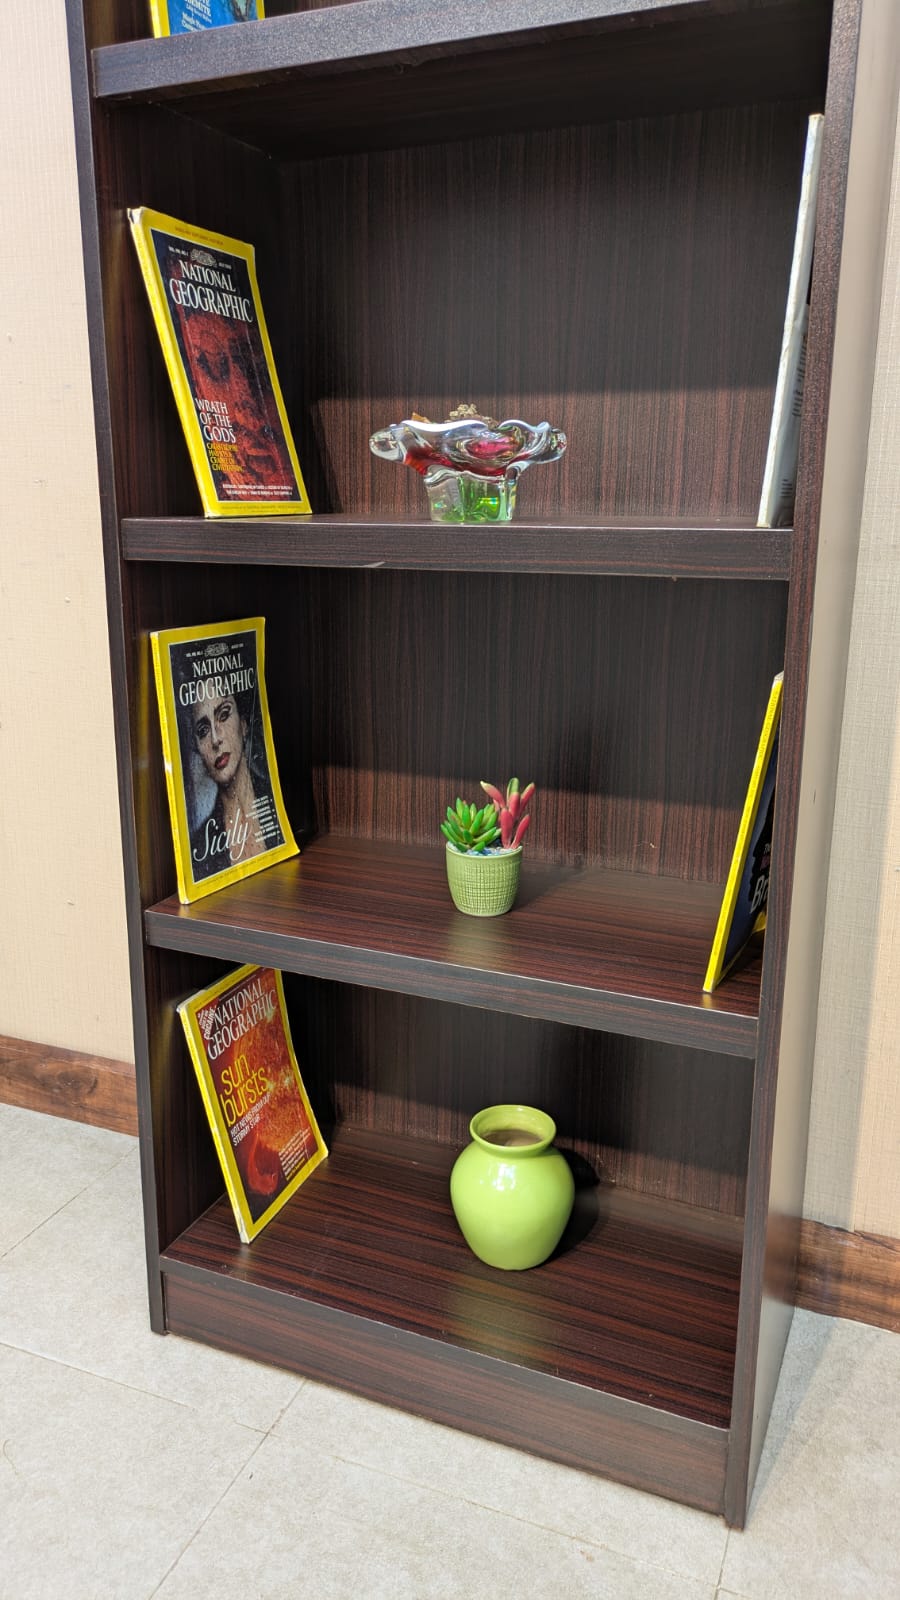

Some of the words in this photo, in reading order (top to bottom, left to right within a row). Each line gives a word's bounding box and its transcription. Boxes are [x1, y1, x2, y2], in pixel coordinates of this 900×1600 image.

[179, 260, 236, 292] NATIONAL
[169, 278, 253, 322] GEOGRAPHIC
[195, 398, 228, 414] WRATH
[200, 412, 213, 425] OF
[213, 413, 233, 428] THE
[203, 425, 236, 443] GODS
[192, 653, 243, 677] NATIONAL
[179, 668, 254, 706] GEOGRAPHIC
[193, 808, 248, 861] Sicily
[214, 978, 265, 1031] NATIONAL
[207, 989, 276, 1060] GEOGRAPHIC
[221, 1055, 250, 1095] sun
[220, 1067, 269, 1127] bursts
